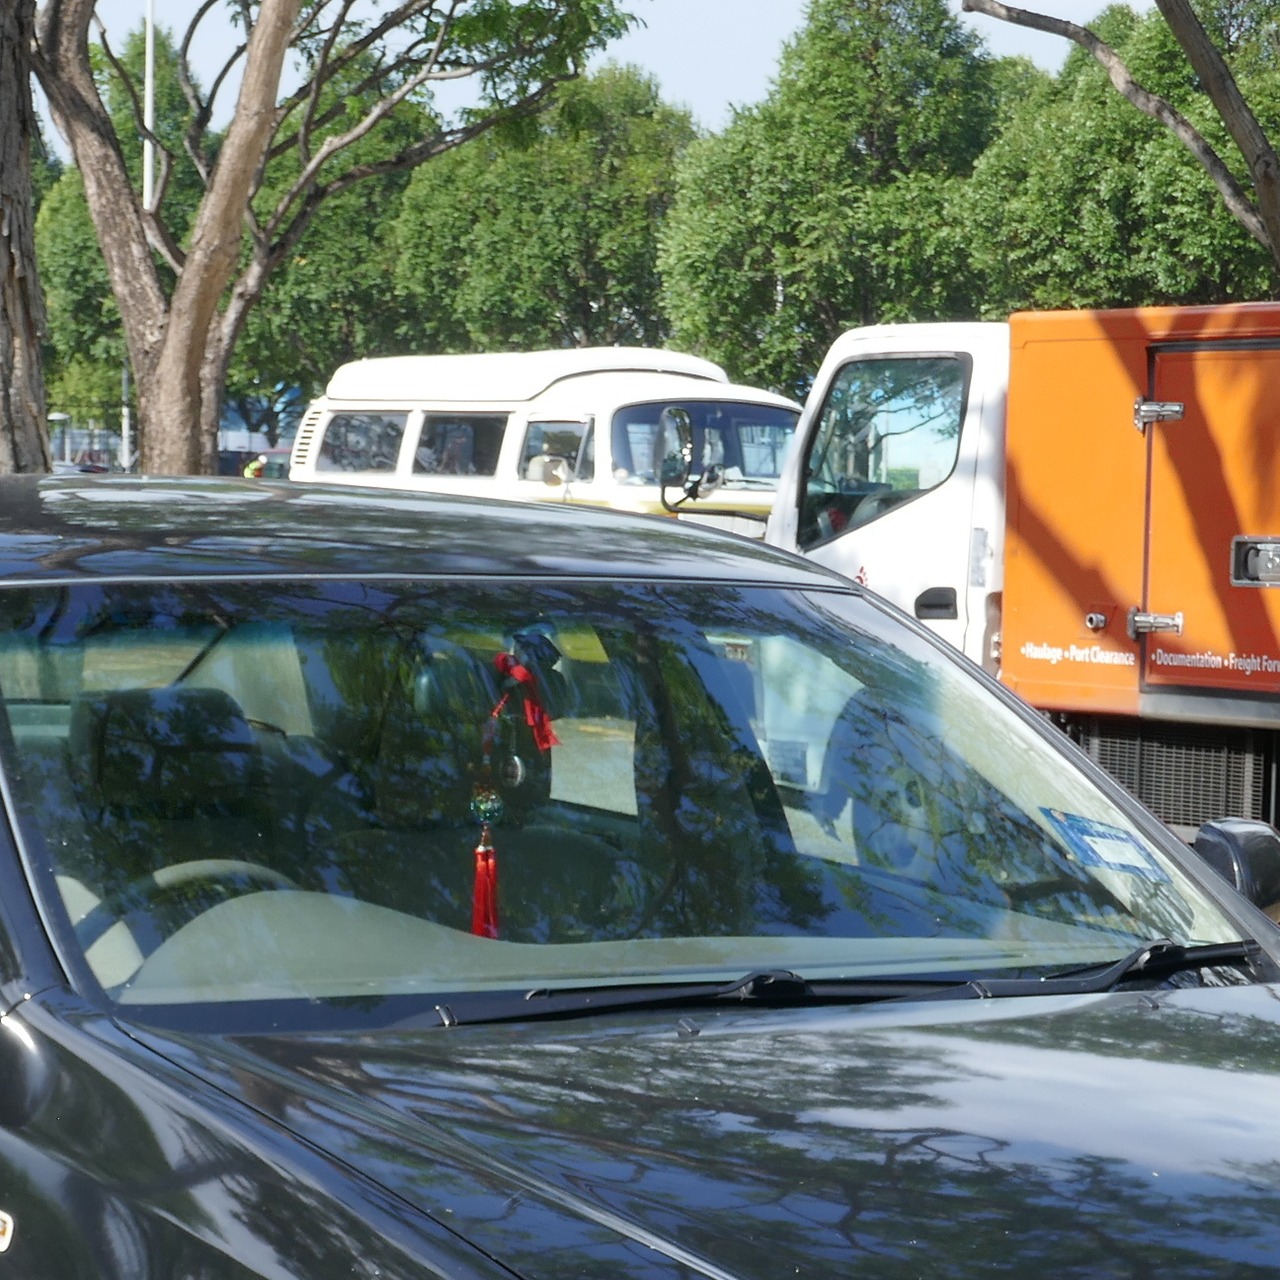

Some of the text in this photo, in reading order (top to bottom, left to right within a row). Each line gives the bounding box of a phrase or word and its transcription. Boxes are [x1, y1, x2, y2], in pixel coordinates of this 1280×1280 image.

[1091, 646, 1135, 665] Clearance
[1156, 650, 1222, 669] Documentation
[1228, 656, 1262, 675] Freight
